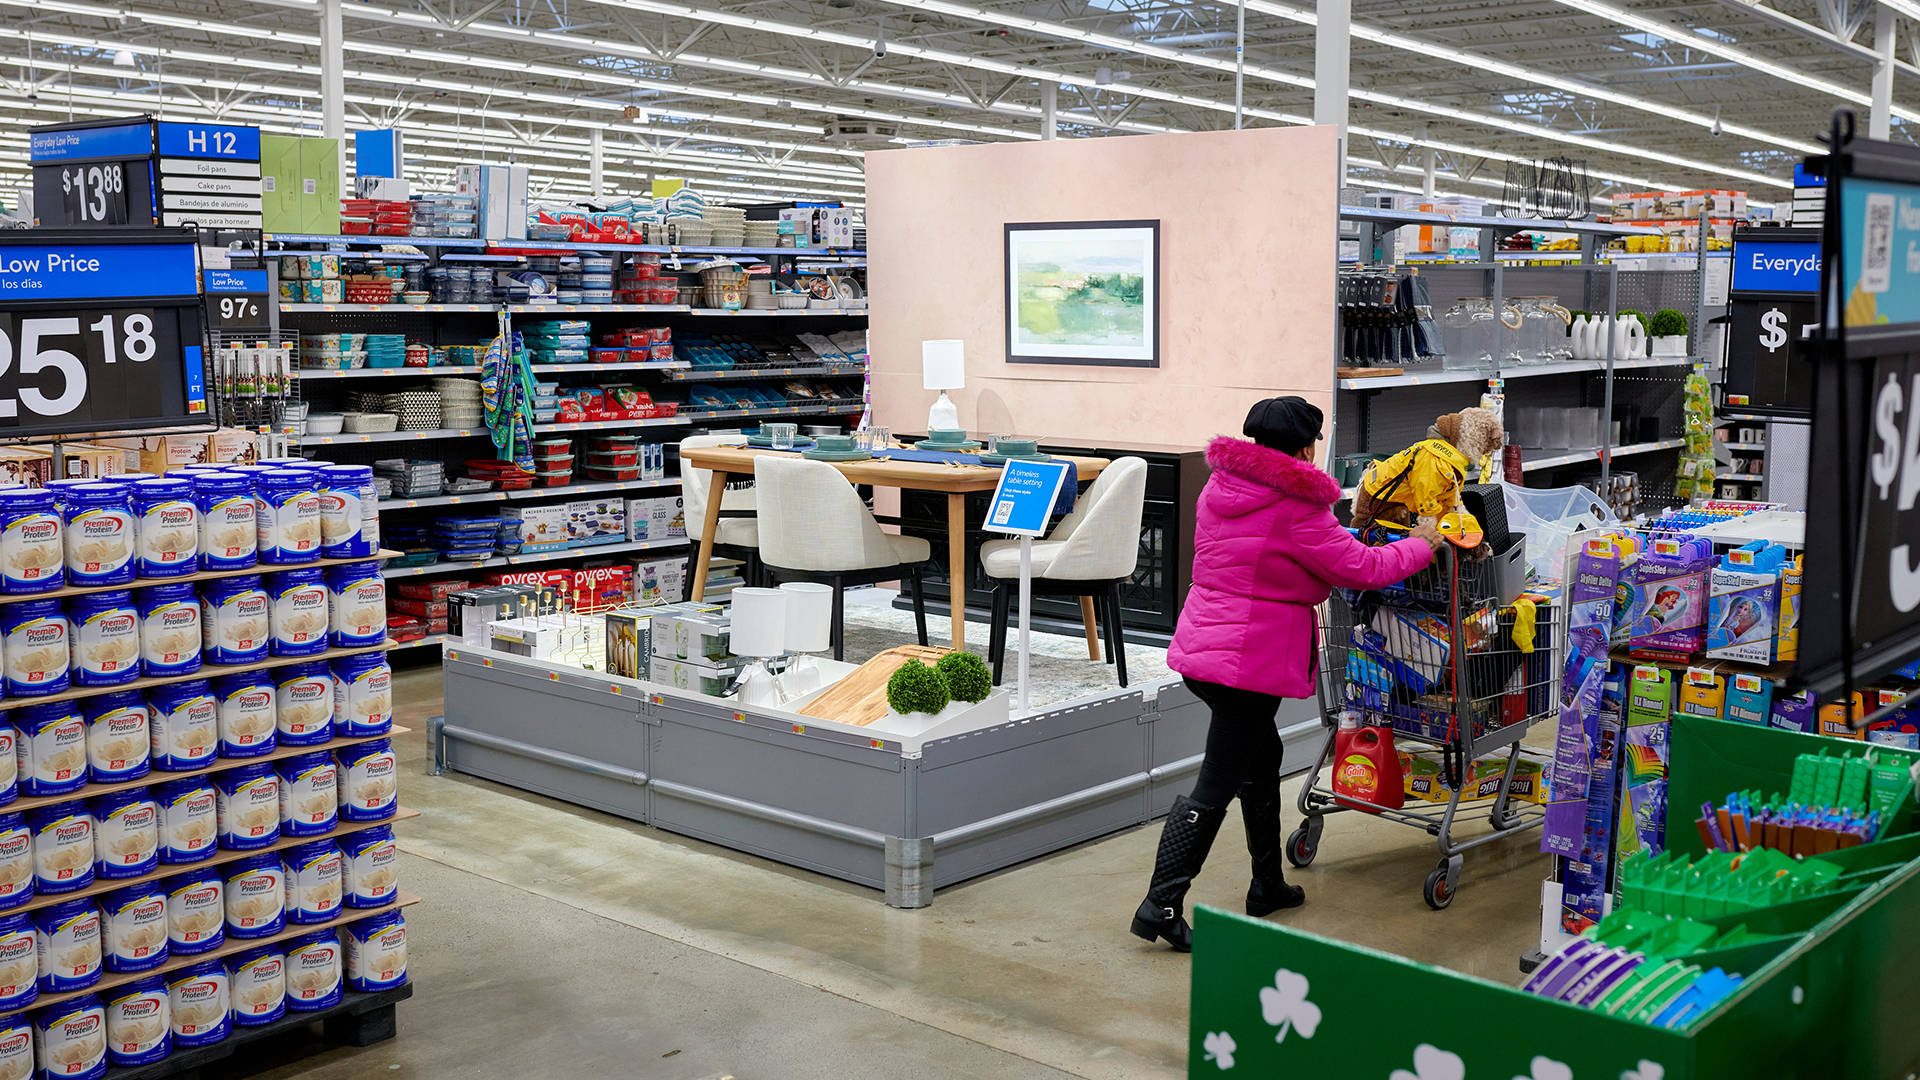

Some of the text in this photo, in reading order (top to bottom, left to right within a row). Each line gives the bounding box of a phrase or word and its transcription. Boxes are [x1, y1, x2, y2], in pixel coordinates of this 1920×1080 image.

[34, 134, 80, 150] Everyday Low Price
[188, 130, 236, 154] H 12
[197, 164, 210, 172] Foil
[197, 182, 215, 190] Cake
[180, 198, 249, 208] Bandejas de aluminio
[208, 218, 224, 226] para
[0, 254, 100, 272] Low Price
[1752, 253, 1822, 276] Everyda
[2, 278, 42, 288] los días
[212, 278, 244, 286] Low Price
[192, 384, 201, 393] FT
[1010, 468, 1040, 478] A timeless
[1008, 476, 1042, 488] table setting
[1724, 488, 1734, 496] M
[1752, 488, 1758, 498] S
[160, 510, 188, 518] Premier
[226, 506, 250, 514] Premier
[162, 516, 188, 524] Protein
[227, 512, 250, 520] Protein
[652, 511, 666, 520] GLASS
[84, 520, 114, 528] Premier
[22, 524, 52, 534] Premier
[85, 526, 113, 534] Protein
[24, 531, 50, 539] Protein
[1639, 564, 1667, 575] SuperSled
[502, 572, 548, 586] pyrex
[574, 568, 613, 588] pyrex
[1690, 578, 1698, 586] 32
[1712, 574, 1740, 586] SuperSled
[1784, 573, 1802, 585] SuperS
[357, 587, 381, 596] Premier
[437, 583, 462, 593] pyrex
[292, 592, 320, 601] Premier
[358, 592, 380, 600] Protein
[1764, 589, 1772, 597] 32
[1596, 602, 1612, 618] 50
[162, 610, 190, 620] Premier
[100, 618, 130, 628] Premier
[164, 618, 189, 626] Protein
[102, 624, 128, 633] Protein
[490, 625, 495, 637] 3
[290, 685, 318, 694] Premier
[240, 695, 266, 704] Premier
[1634, 696, 1642, 706] DLX
[1684, 702, 1694, 713] DLX
[1730, 704, 1740, 717] DLX
[108, 718, 138, 726] Premier
[110, 724, 136, 732] Protein
[1650, 726, 1664, 741] 25
[366, 761, 390, 770] Premier
[368, 766, 389, 774] Protein
[1346, 765, 1366, 777] Gain
[250, 786, 274, 796] Premier
[251, 792, 274, 801] Protein
[56, 825, 86, 836] Premier
[58, 832, 84, 841] Protein
[240, 878, 269, 887] Premier
[242, 884, 267, 892] Protein
[184, 890, 213, 901] Premier
[185, 898, 212, 906] Protein
[381, 933, 404, 942] Premier
[382, 939, 404, 947] Protein
[300, 952, 329, 960] Premier
[302, 958, 327, 966] Protein
[180, 985, 210, 994] Premier
[182, 992, 208, 1000] Protein
[122, 1002, 153, 1012] Premier
